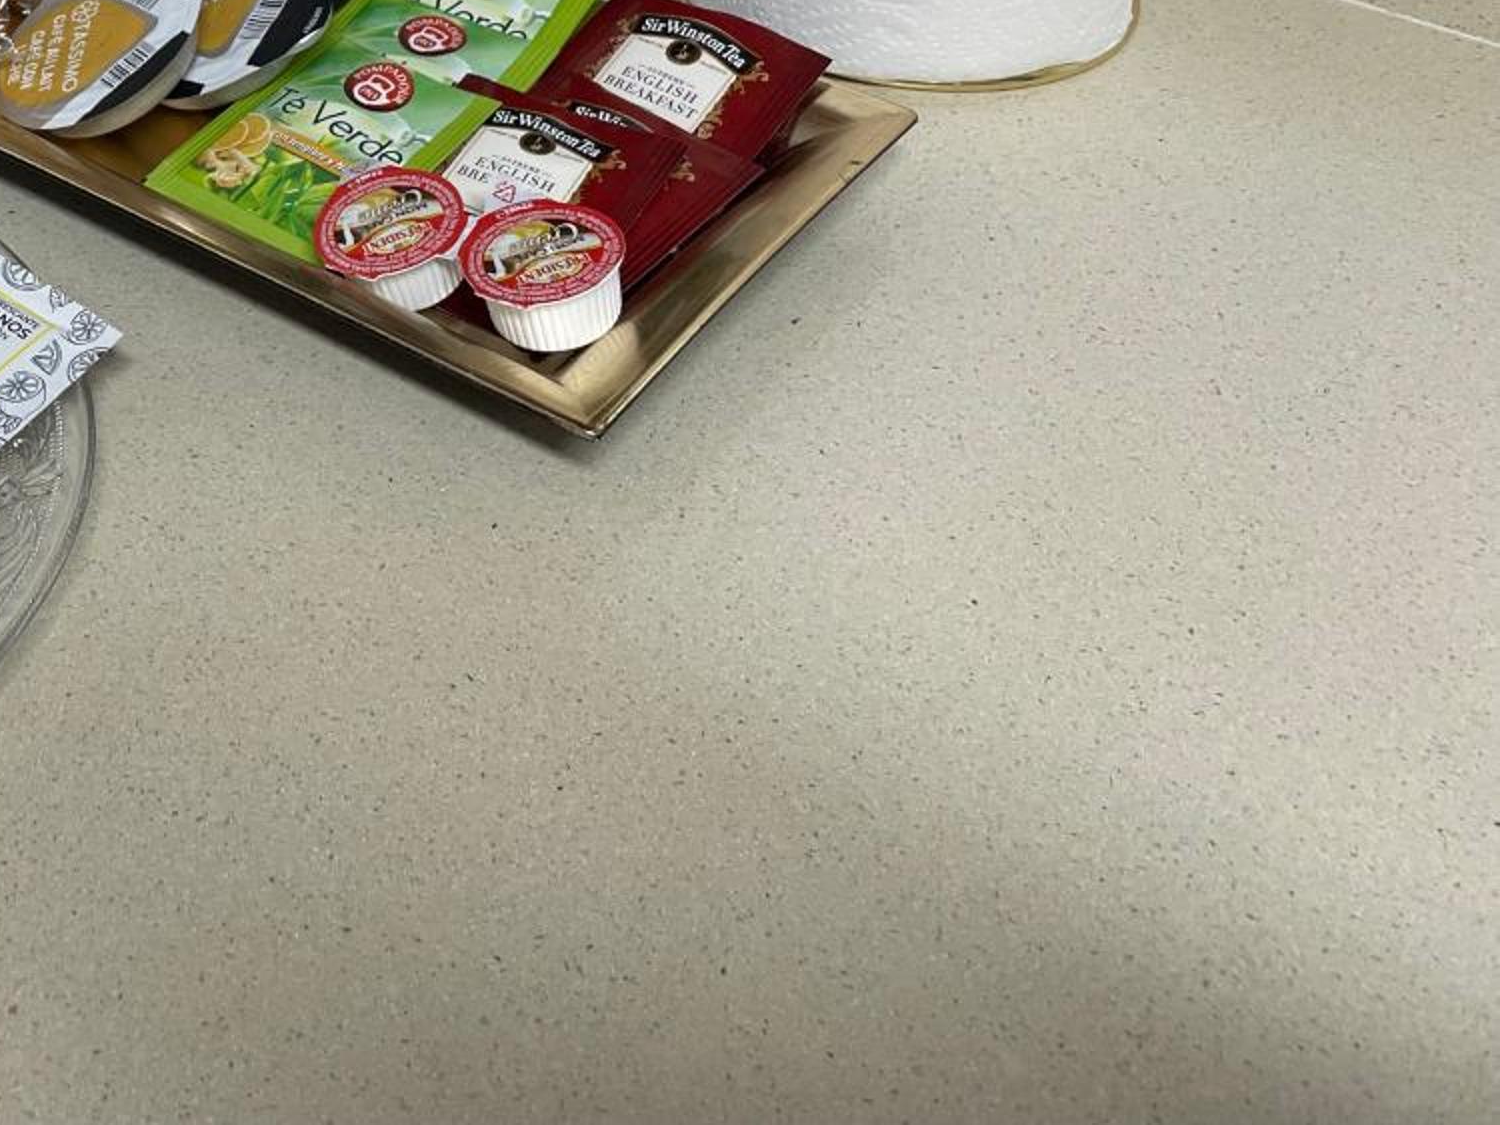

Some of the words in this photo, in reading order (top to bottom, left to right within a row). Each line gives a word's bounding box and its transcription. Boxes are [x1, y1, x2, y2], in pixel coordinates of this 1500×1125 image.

[641, 18, 666, 32] Sir
[665, 19, 724, 53] Winston
[722, 43, 745, 69] Tea
[603, 74, 699, 119] BREAKFAST
[620, 66, 700, 105] ENGLISH
[269, 87, 305, 114] Té
[312, 100, 404, 165] Verde
[492, 110, 518, 125] Sir
[518, 112, 578, 148] Winston
[577, 138, 602, 159] Tea
[457, 165, 490, 184] BRE
[474, 156, 555, 193] ENGLISH
